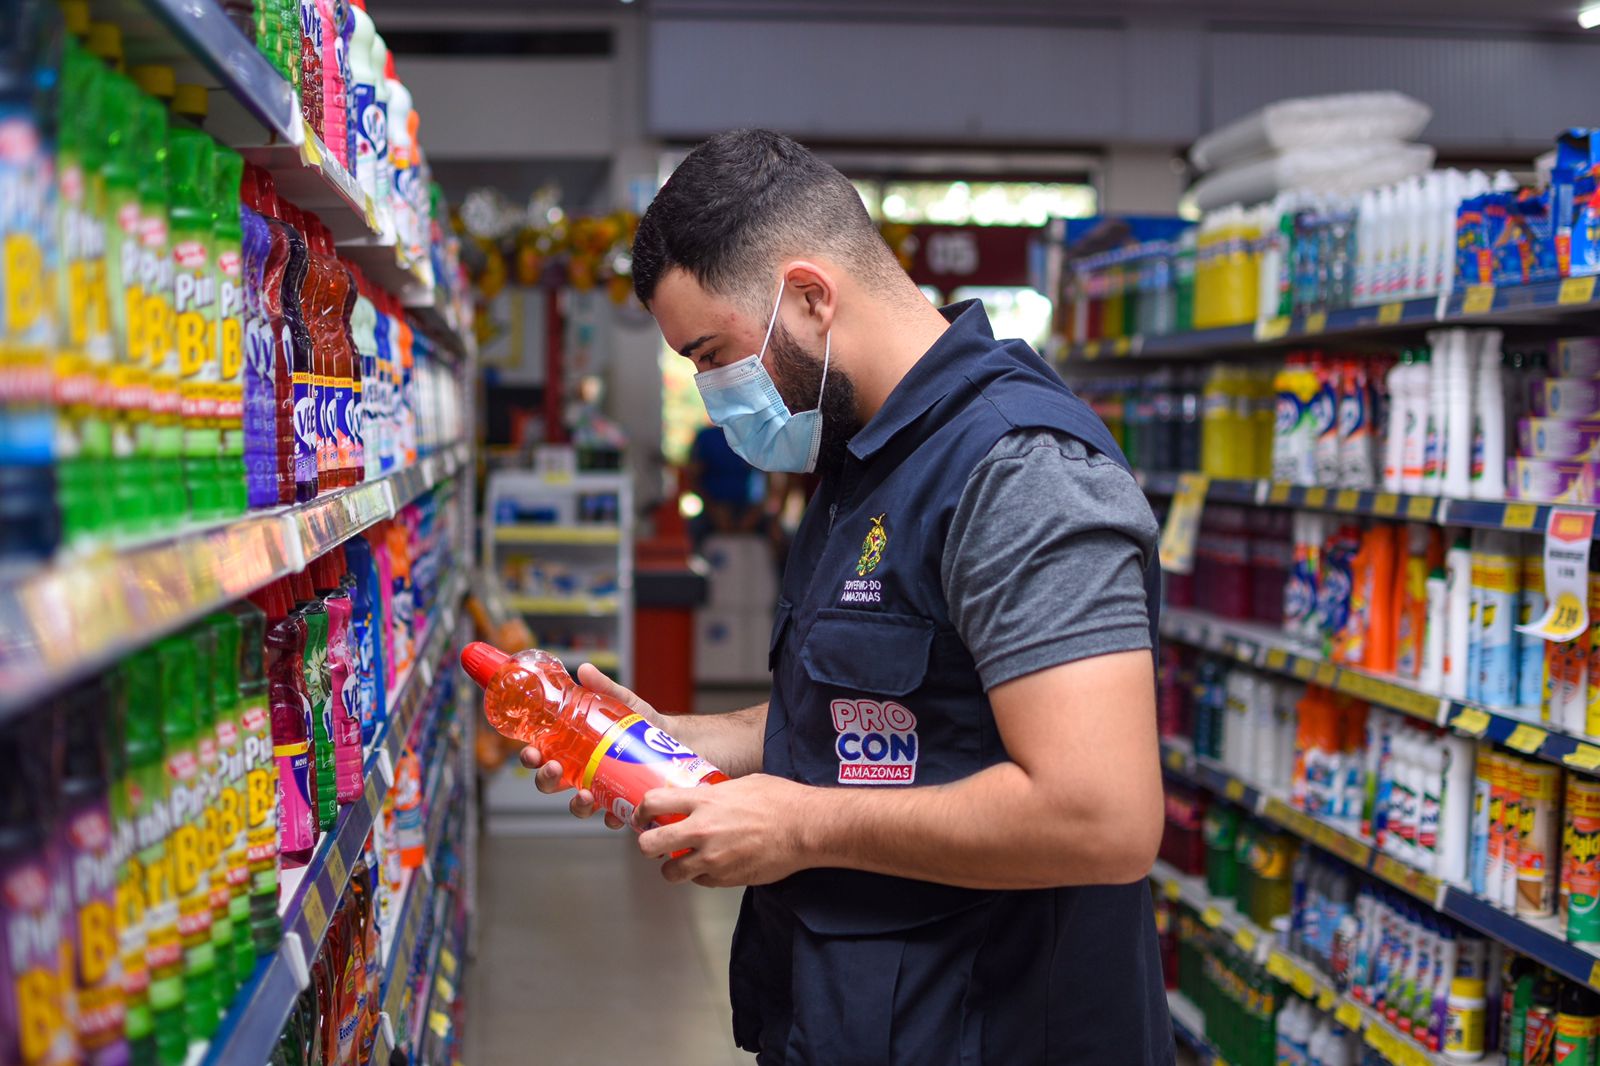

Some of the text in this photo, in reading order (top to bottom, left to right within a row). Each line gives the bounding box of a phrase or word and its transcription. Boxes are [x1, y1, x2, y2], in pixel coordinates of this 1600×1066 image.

[840, 591, 881, 602] AMAZONAS
[833, 701, 915, 731] PRO
[837, 732, 917, 762] CON
[843, 765, 910, 780] AMAZONAS
